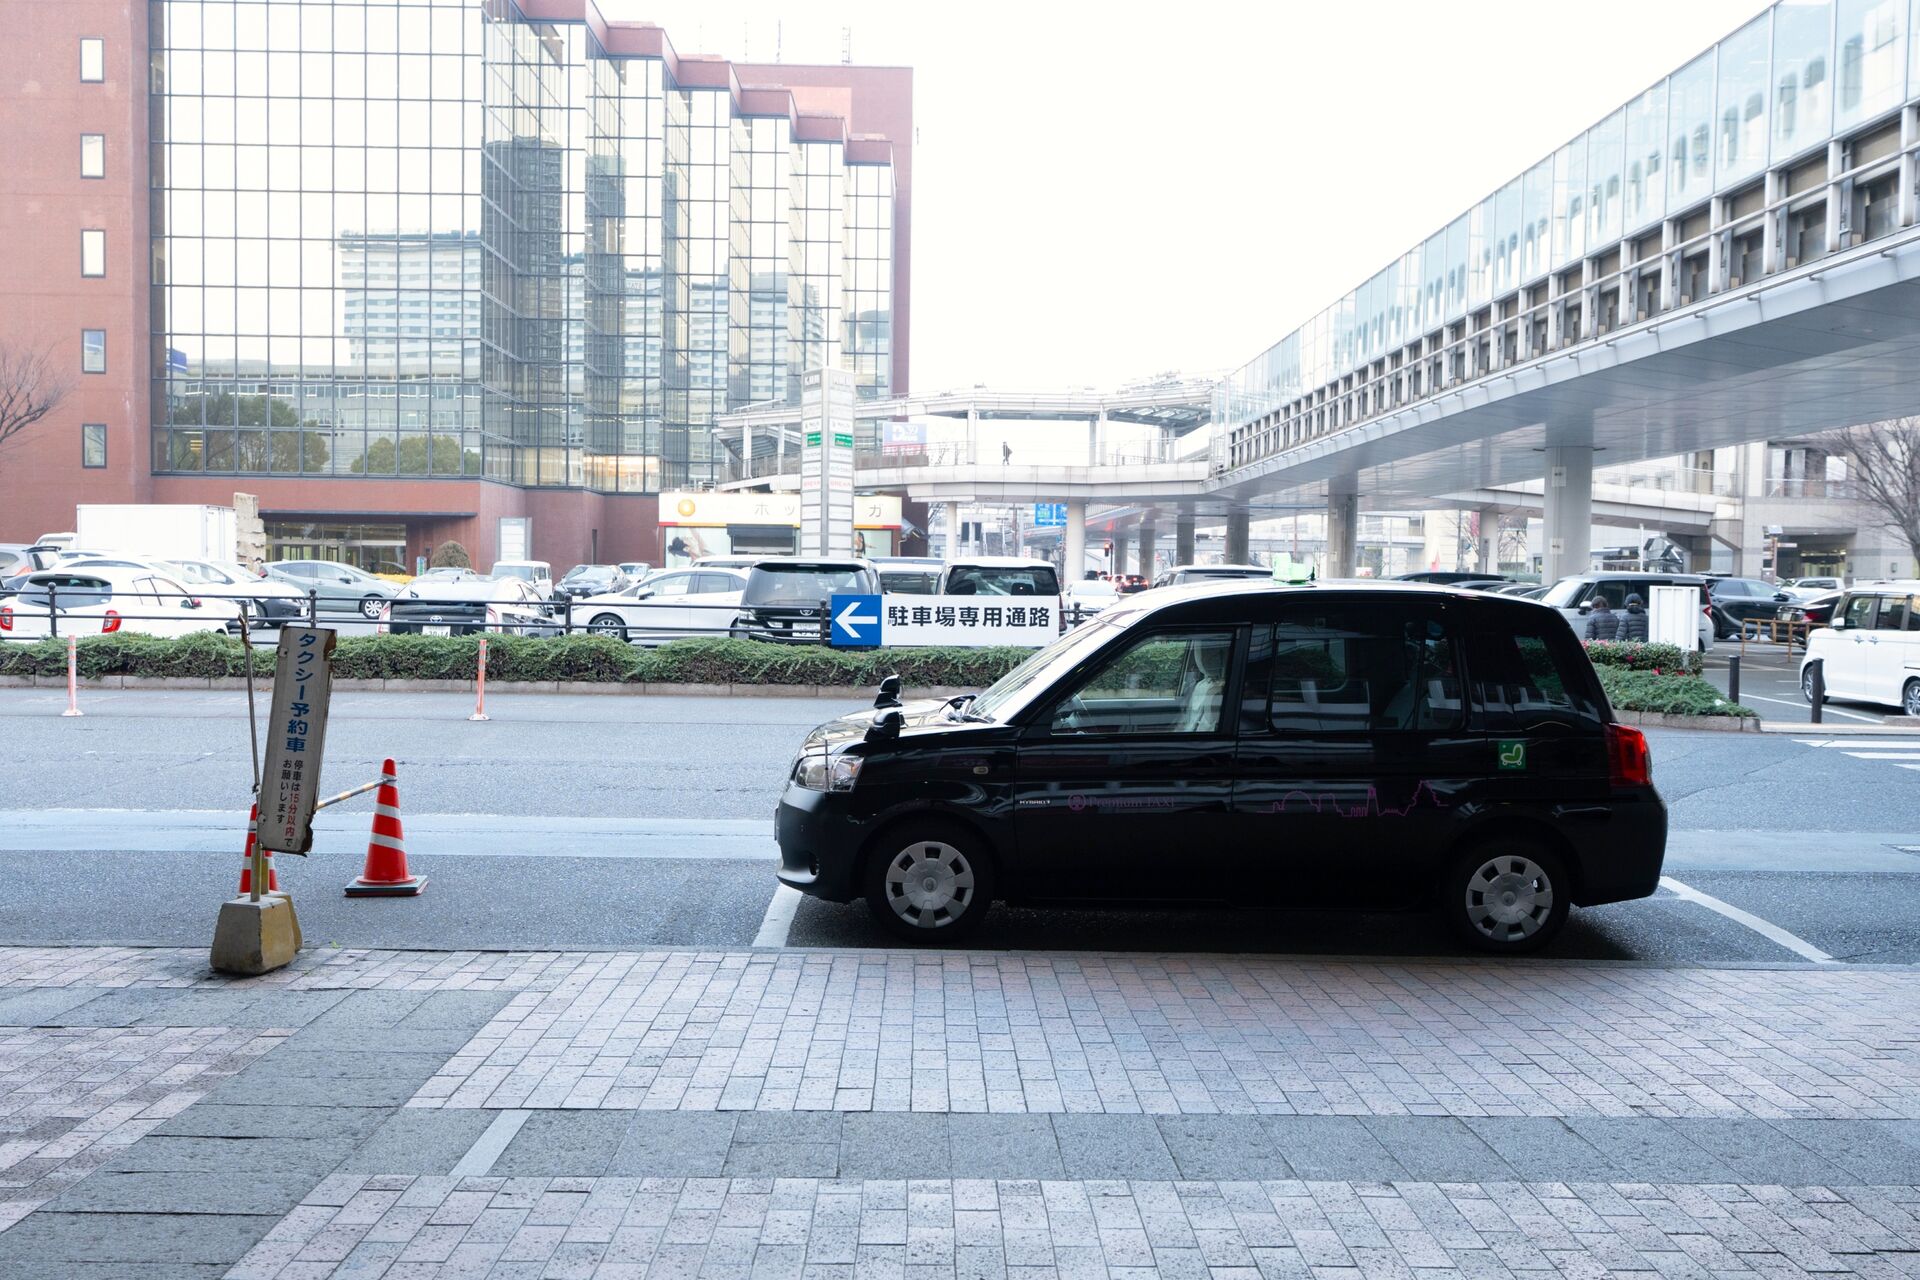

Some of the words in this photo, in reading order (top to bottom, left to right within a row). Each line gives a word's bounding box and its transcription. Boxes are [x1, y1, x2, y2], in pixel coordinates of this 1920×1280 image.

[887, 605, 1050, 628] 駐車場専用通路
[285, 633, 316, 753] タクシー予約車
[276, 759, 292, 824] お願いします
[284, 759, 304, 847] 停車は15分以内で
